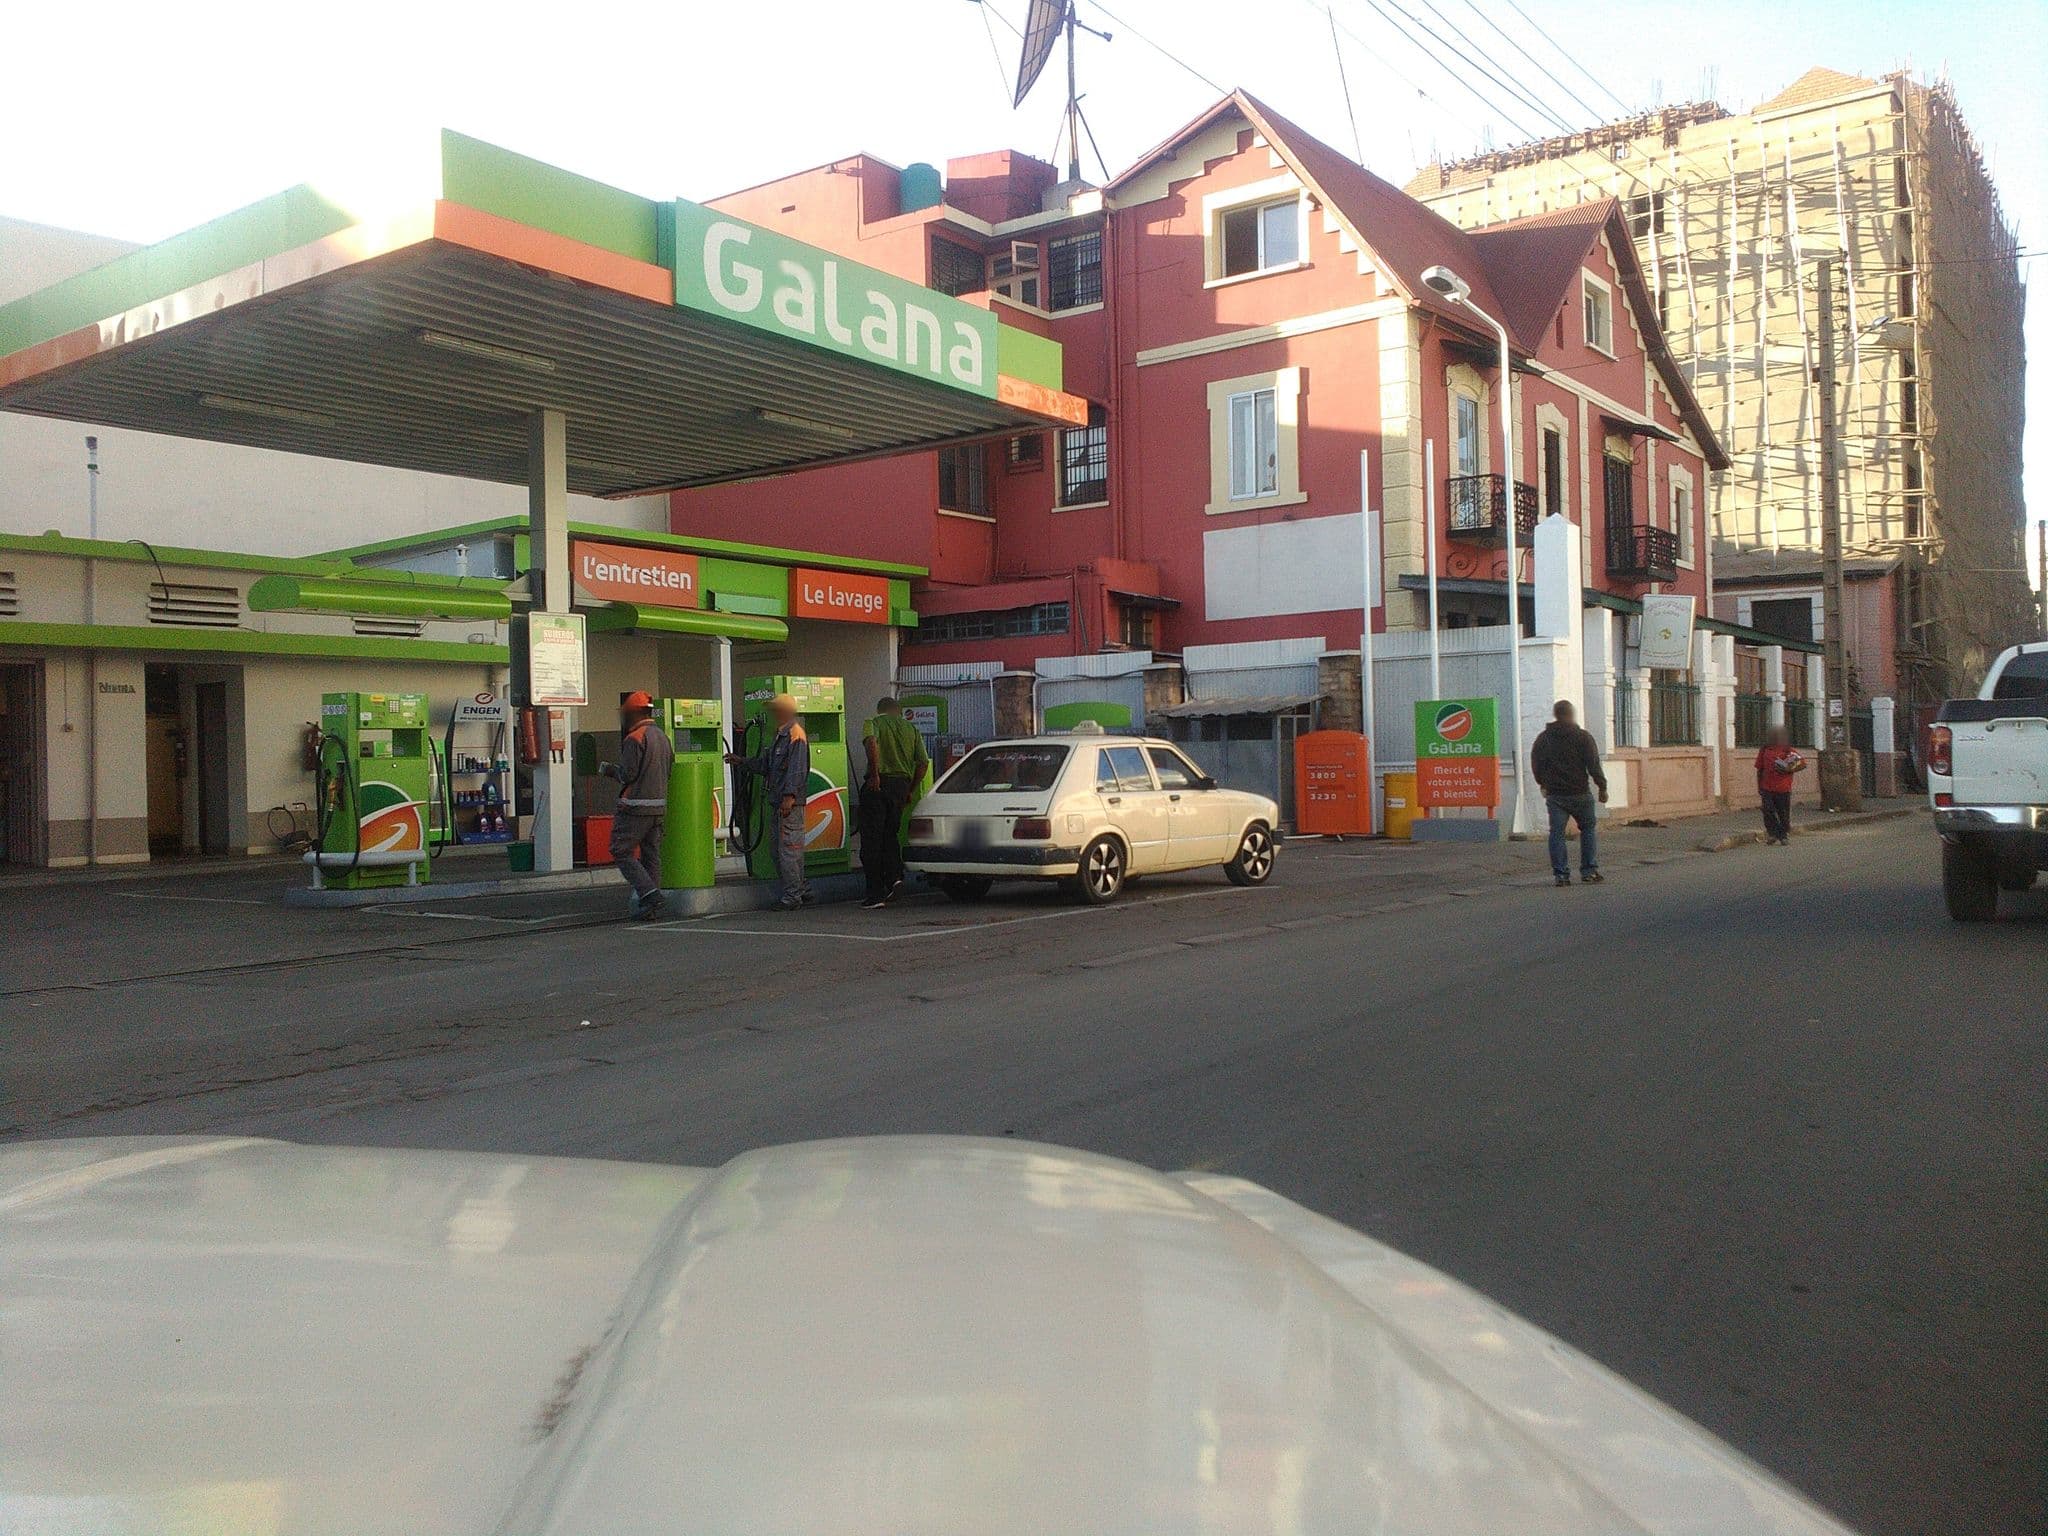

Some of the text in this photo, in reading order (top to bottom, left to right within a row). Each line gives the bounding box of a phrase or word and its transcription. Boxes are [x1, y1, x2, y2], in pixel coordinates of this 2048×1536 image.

[702, 221, 983, 387] Galana
[583, 555, 692, 590] l'entretien
[804, 583, 883, 613] Le lavage
[463, 706, 501, 715] ENGEN
[1428, 742, 1482, 754] Galana
[1434, 765, 1475, 774] Merci de
[1427, 779, 1453, 787] votre
